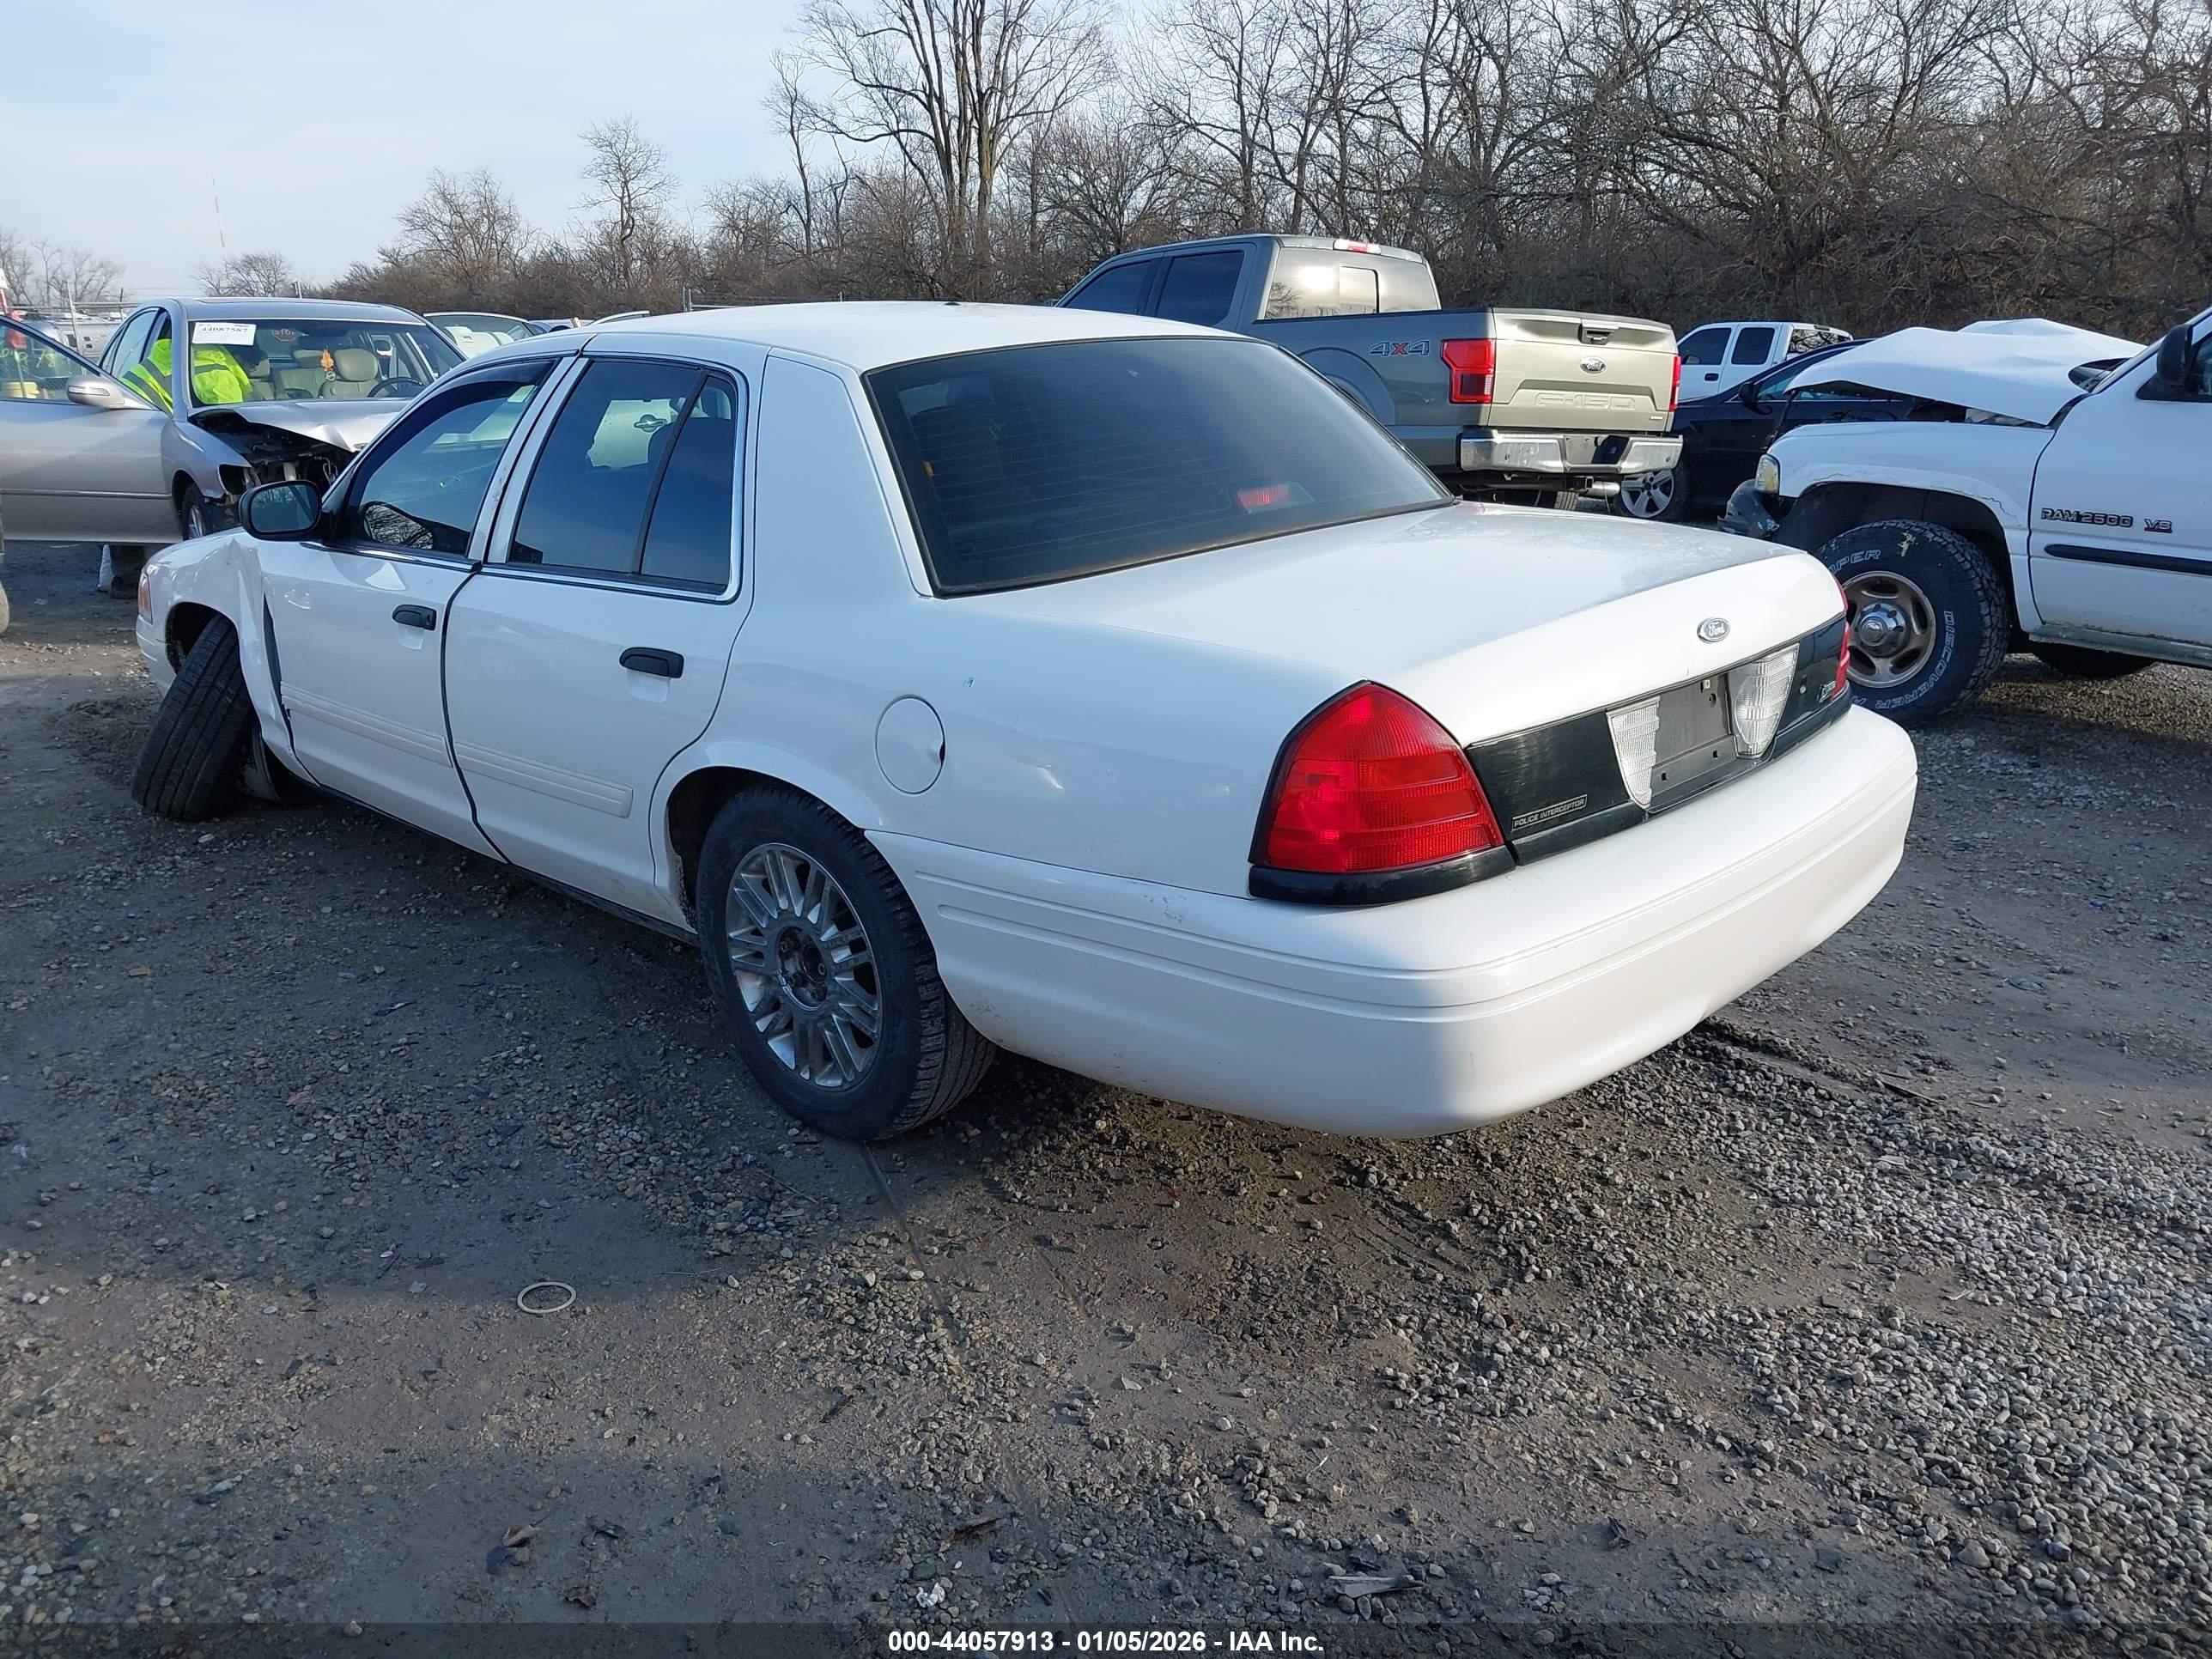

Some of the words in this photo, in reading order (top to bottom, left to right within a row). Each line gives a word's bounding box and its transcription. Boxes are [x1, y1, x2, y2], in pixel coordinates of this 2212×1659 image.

[1535, 392, 1635, 410] F-150
[2041, 507, 2080, 522] RAM
[2081, 511, 2133, 528] 2500
[1875, 611, 1955, 708] DISCOVERER
[1514, 814, 1539, 828] POLICE
[1540, 799, 1585, 818] INTERCEPTOR
